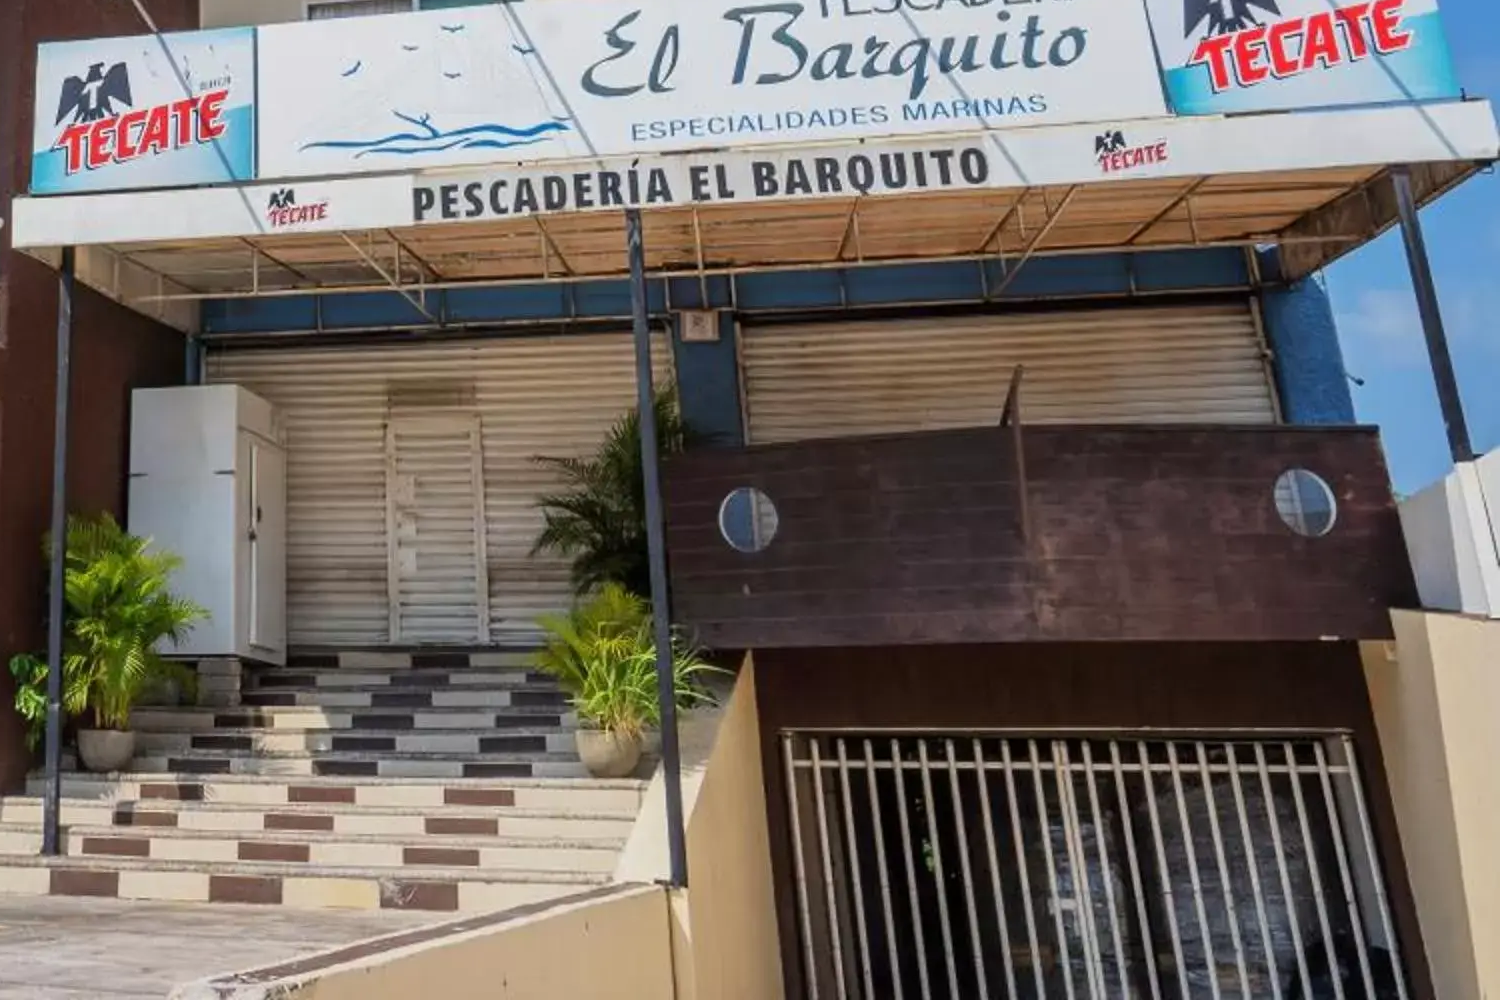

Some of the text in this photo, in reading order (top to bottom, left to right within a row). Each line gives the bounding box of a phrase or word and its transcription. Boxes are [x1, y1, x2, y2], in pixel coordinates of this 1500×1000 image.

[581, 2, 1087, 100] El Barquito
[57, 88, 229, 175] TECATE
[632, 95, 1048, 142] ESPECIALIDADES MARINAS
[414, 148, 990, 221] PESCADERÍA EL BARQUITO
[1100, 142, 1167, 172] TECATE
[267, 200, 330, 227] TECATE
